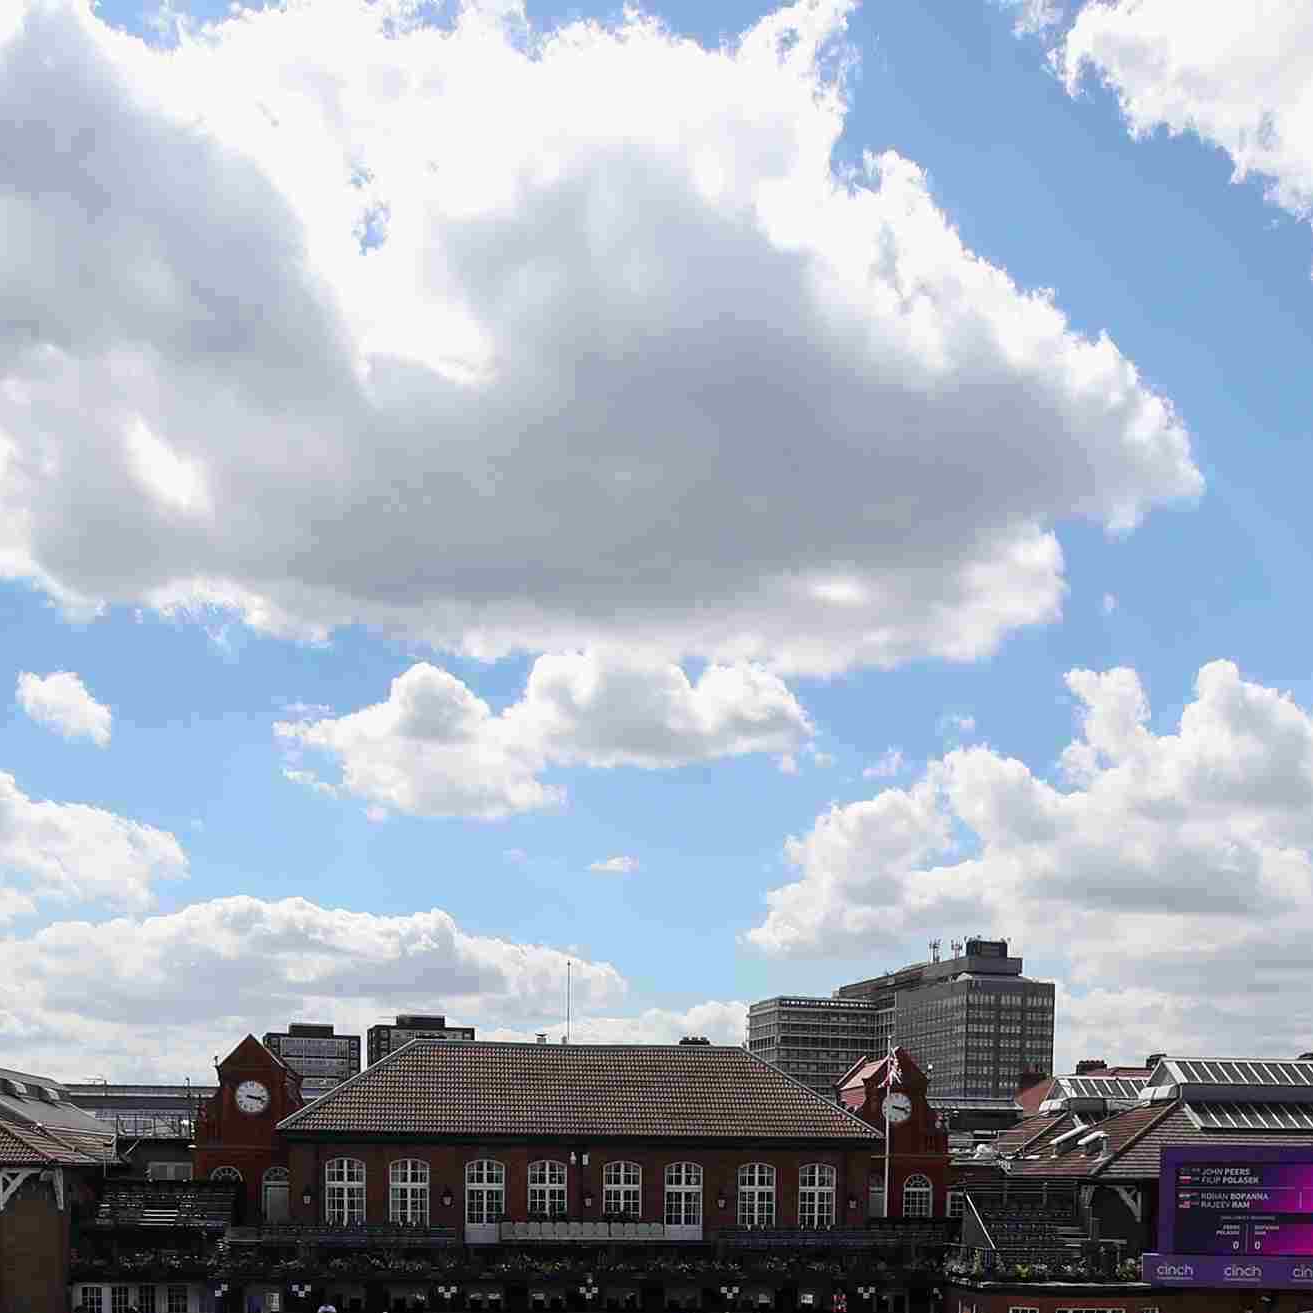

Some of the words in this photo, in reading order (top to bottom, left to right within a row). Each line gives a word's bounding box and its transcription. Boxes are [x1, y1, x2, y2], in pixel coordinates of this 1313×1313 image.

[1201, 1168, 1223, 1176] JOHN
[1224, 1168, 1251, 1176] PEERS
[1230, 1192, 1271, 1201] BOPANNA
[1231, 1200, 1251, 1209] RAM
[1156, 1263, 1194, 1277] cinch
[1223, 1263, 1262, 1278] cinch
